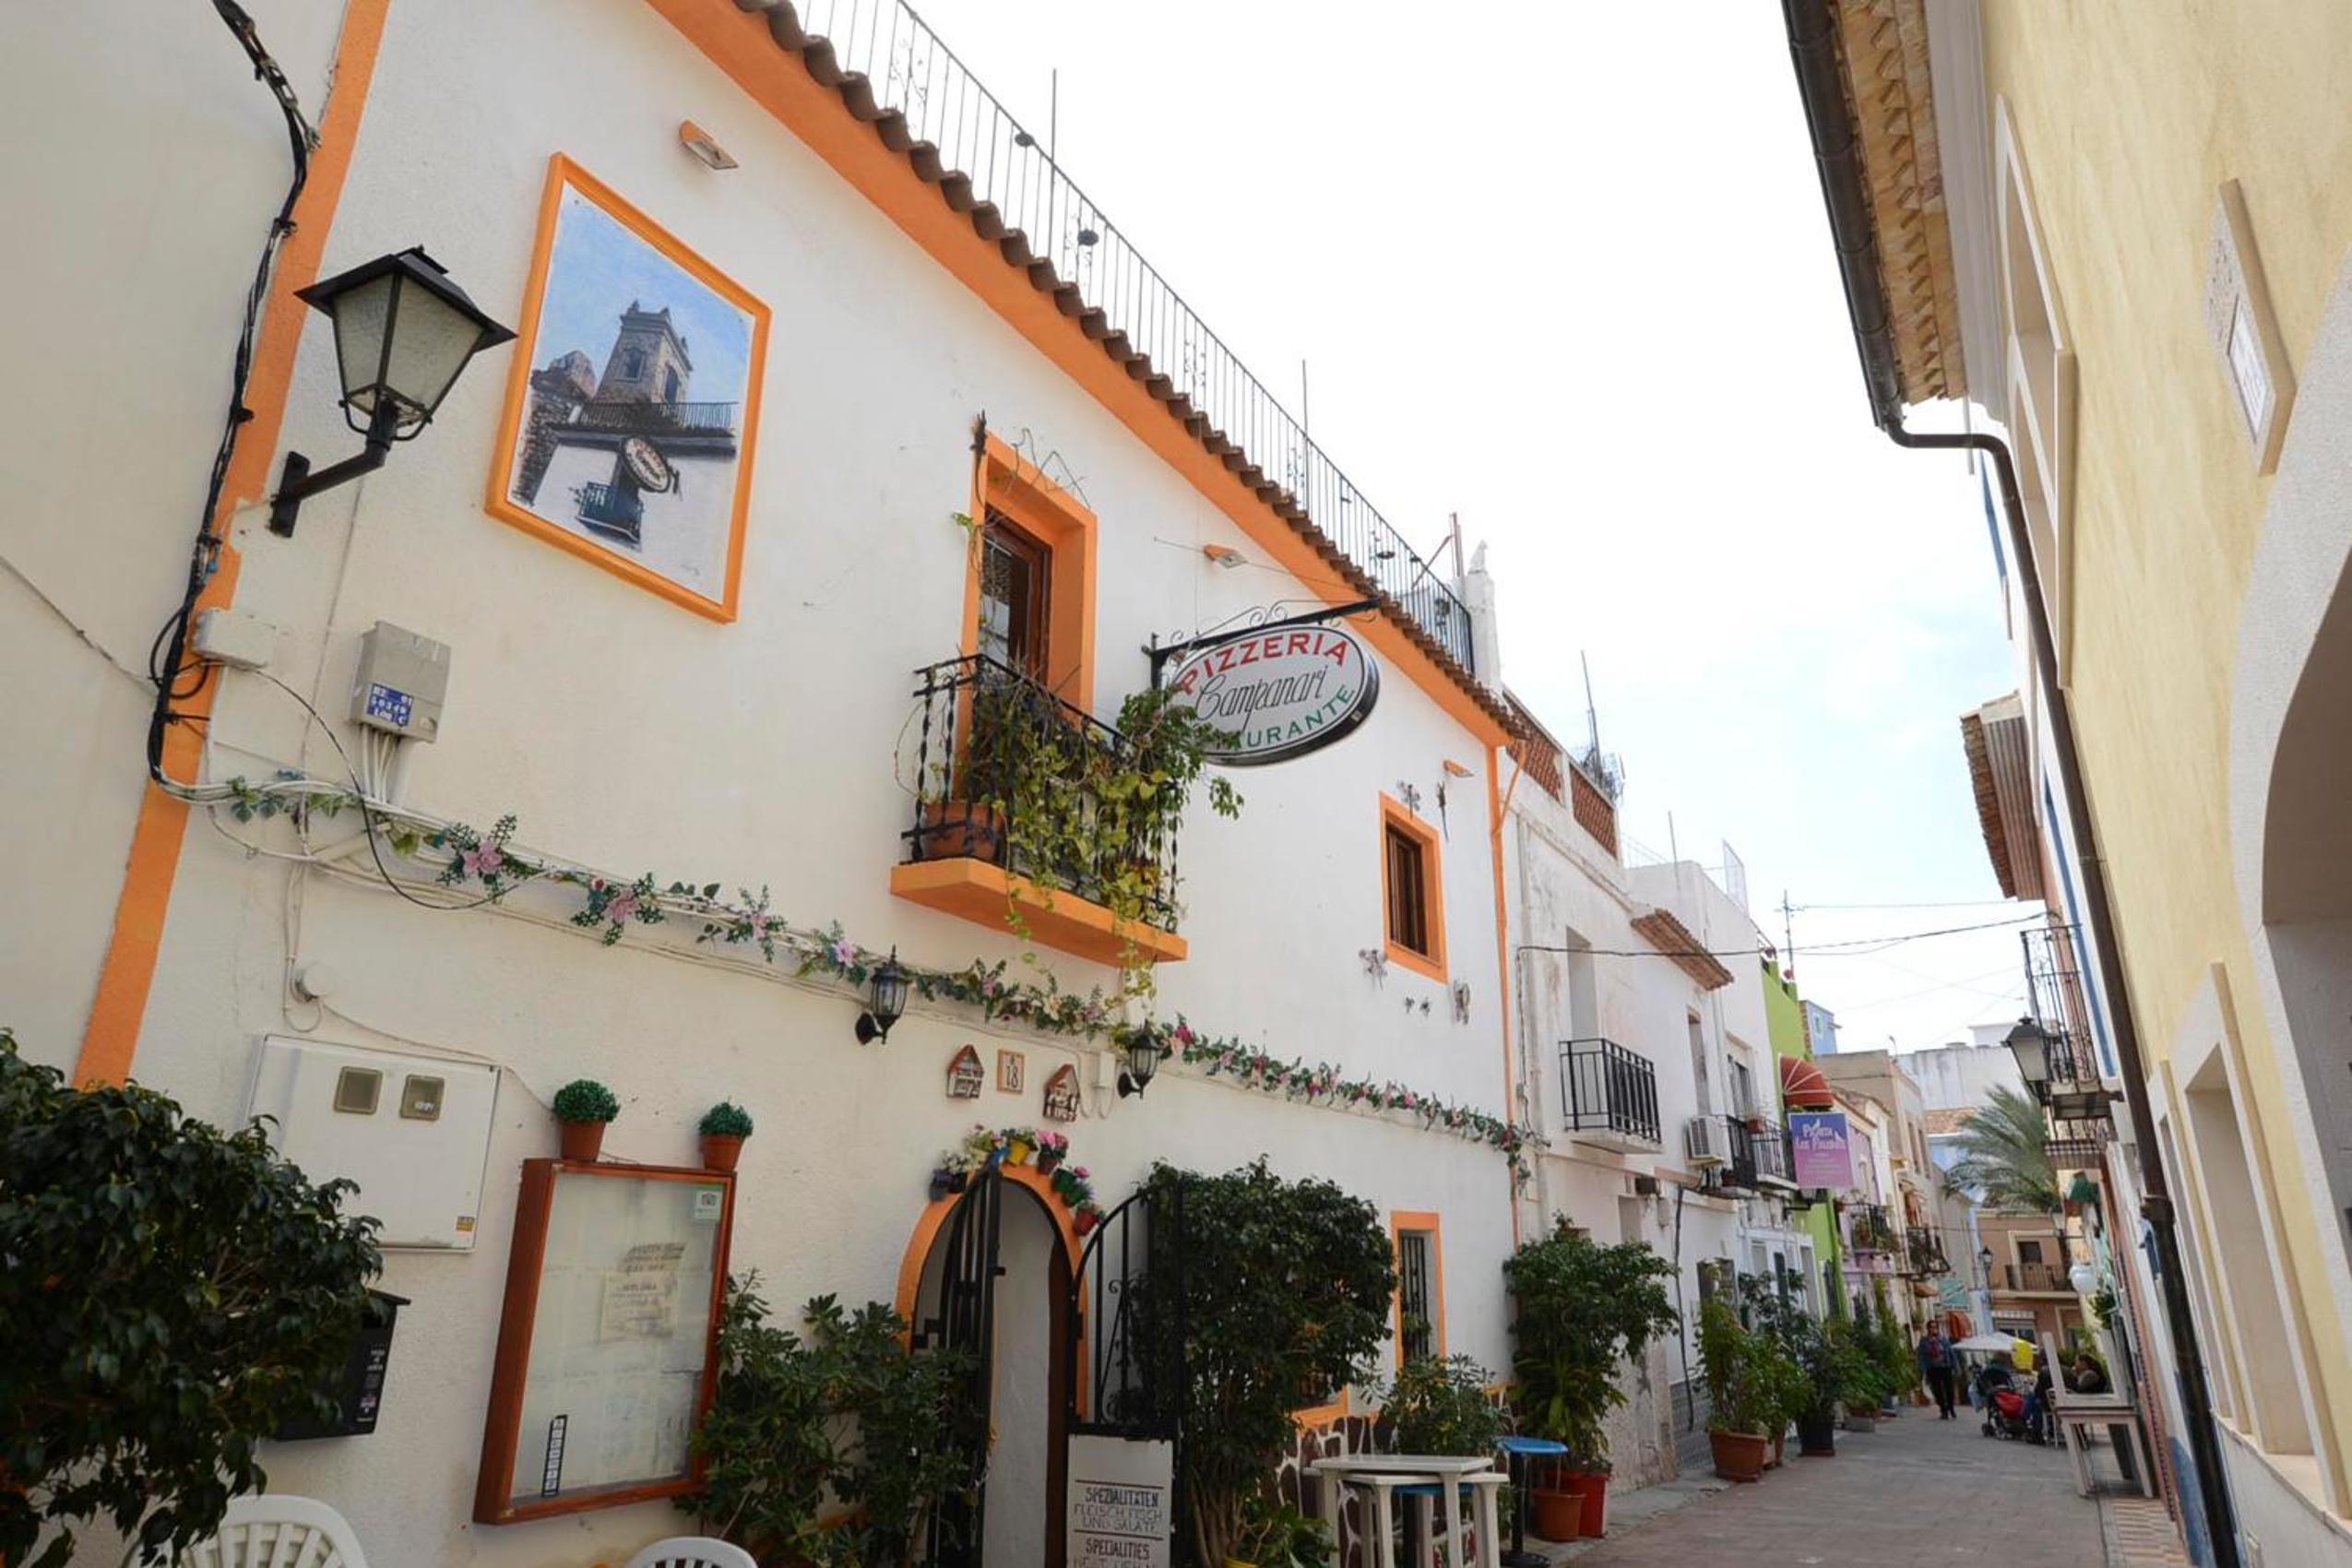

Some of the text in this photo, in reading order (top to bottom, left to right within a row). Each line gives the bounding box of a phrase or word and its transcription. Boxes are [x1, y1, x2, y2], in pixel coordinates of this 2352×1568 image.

[1178, 633, 1348, 695] PIZZERIA
[1194, 665, 1329, 731] Campanari
[1233, 683, 1356, 751] URANTE
[1006, 1065, 1018, 1088] 18
[1086, 1538, 1150, 1560] SPECIALITIES
